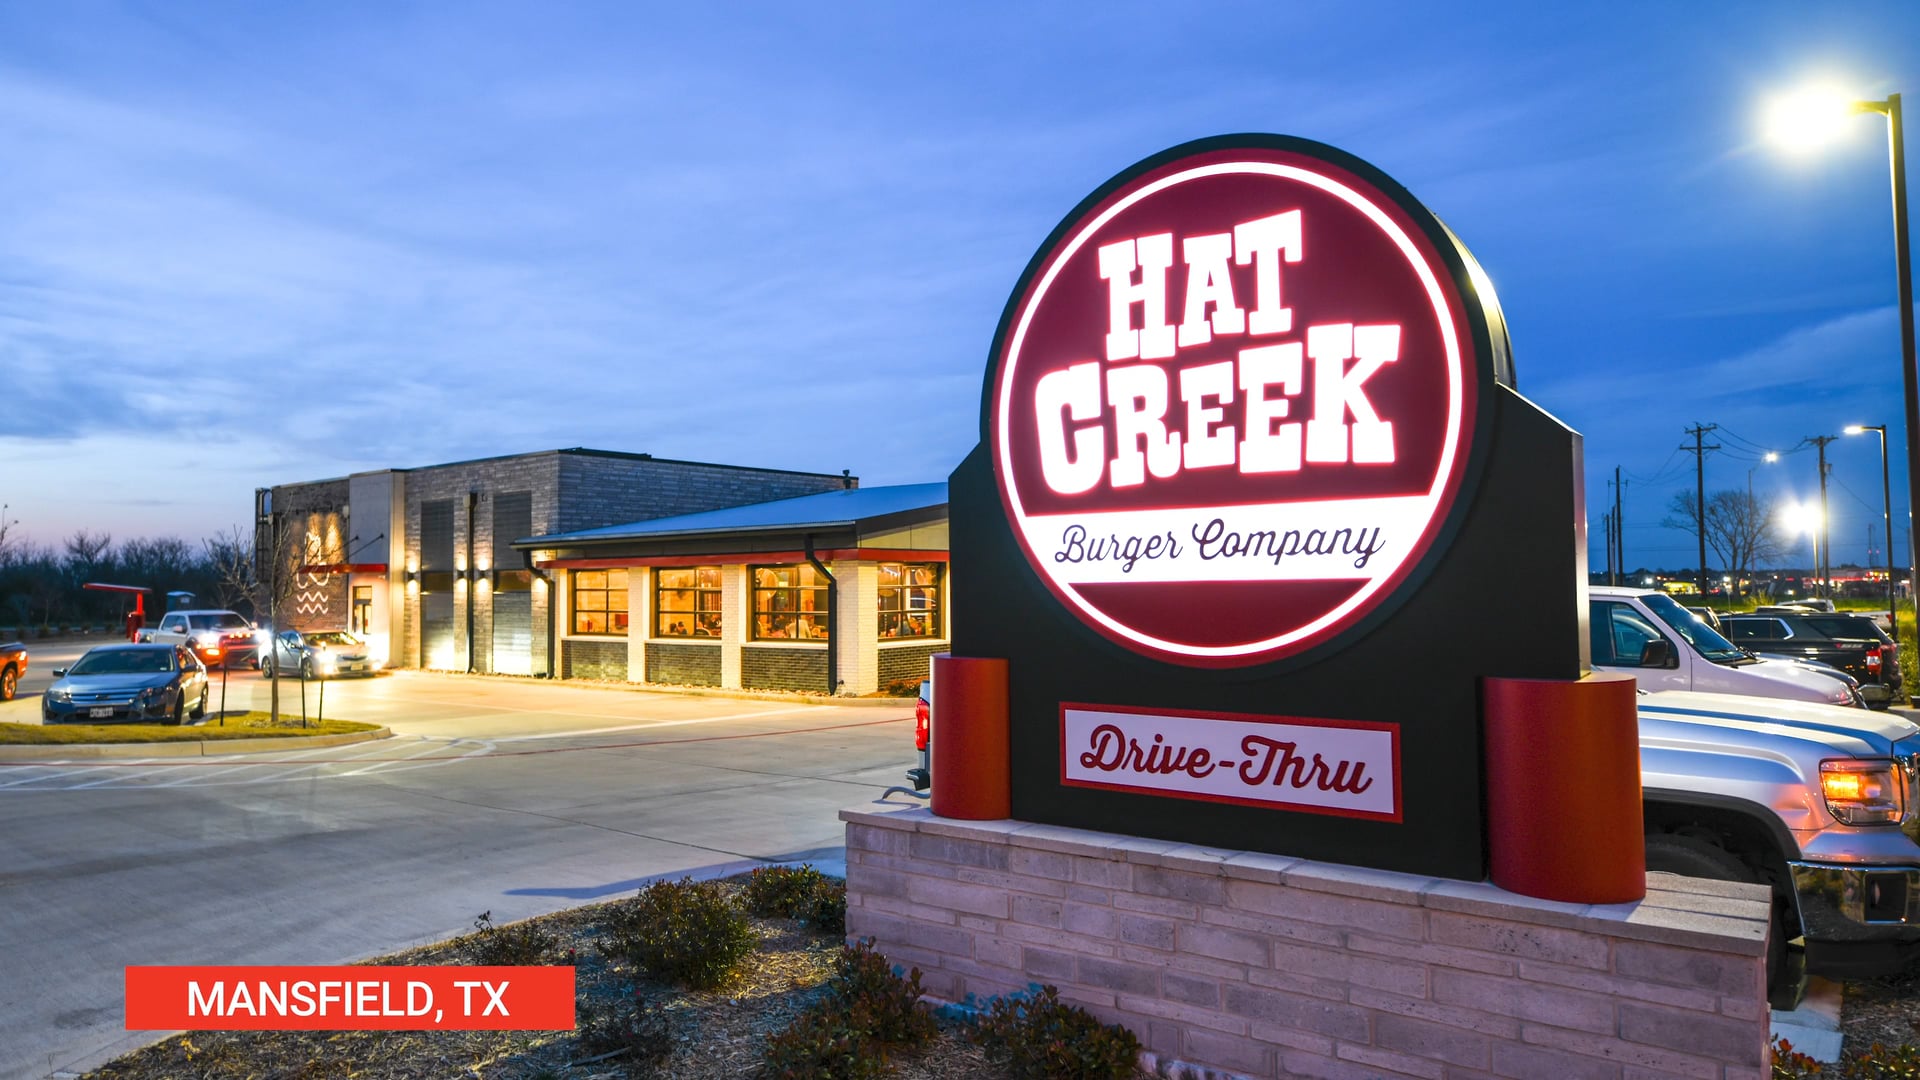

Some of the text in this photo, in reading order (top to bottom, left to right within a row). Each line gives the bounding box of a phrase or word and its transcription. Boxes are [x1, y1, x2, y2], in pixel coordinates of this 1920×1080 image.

[1098, 209, 1303, 361] HAT
[1035, 323, 1401, 494] CREEK
[1054, 518, 1386, 573] Burger Company
[1080, 724, 1373, 794] Drive-Thru
